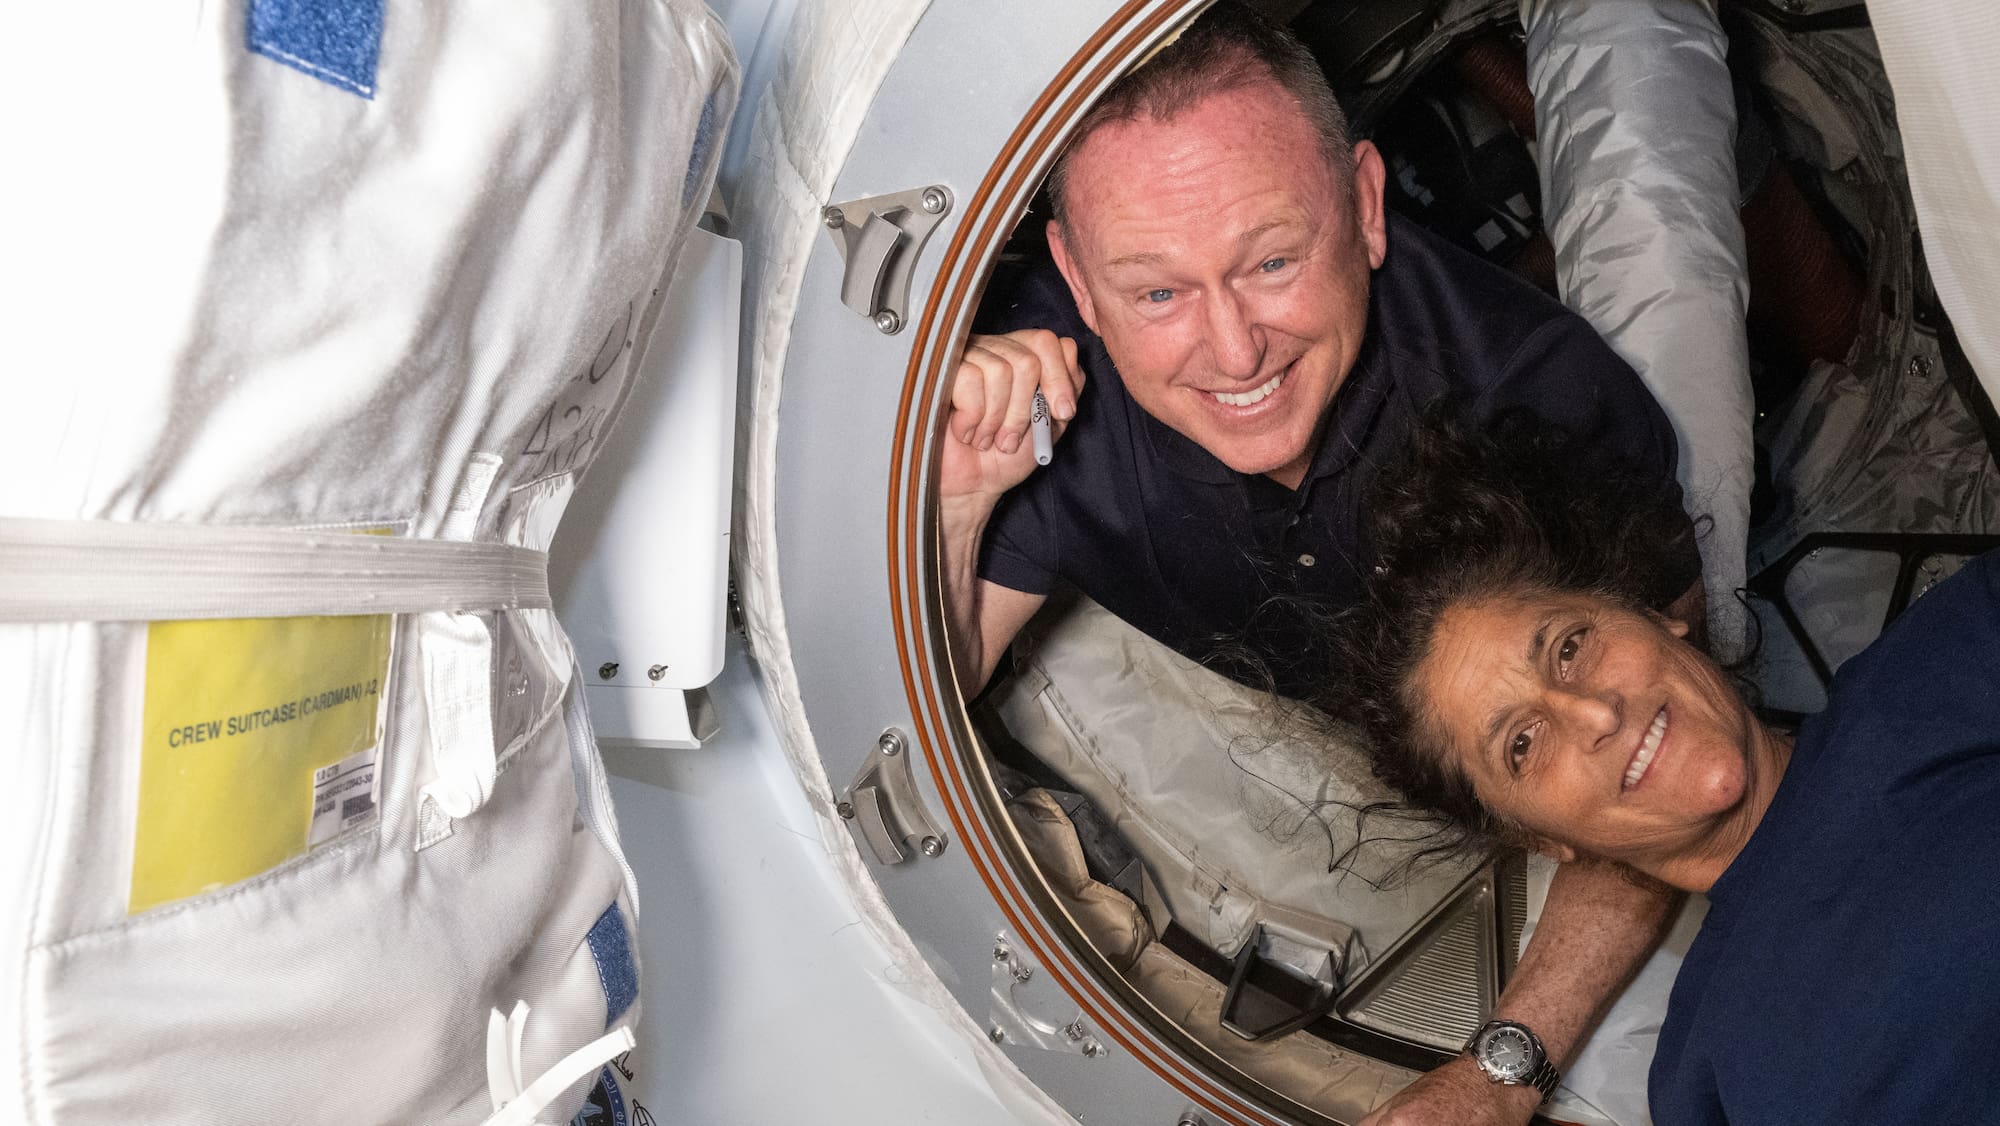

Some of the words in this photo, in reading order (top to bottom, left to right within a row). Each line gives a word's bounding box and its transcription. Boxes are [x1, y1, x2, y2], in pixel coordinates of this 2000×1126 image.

[169, 720, 222, 748] CREW
[227, 702, 296, 735] SUITCASE
[299, 684, 362, 719] (CARDMAN)
[364, 678, 377, 697] A2
